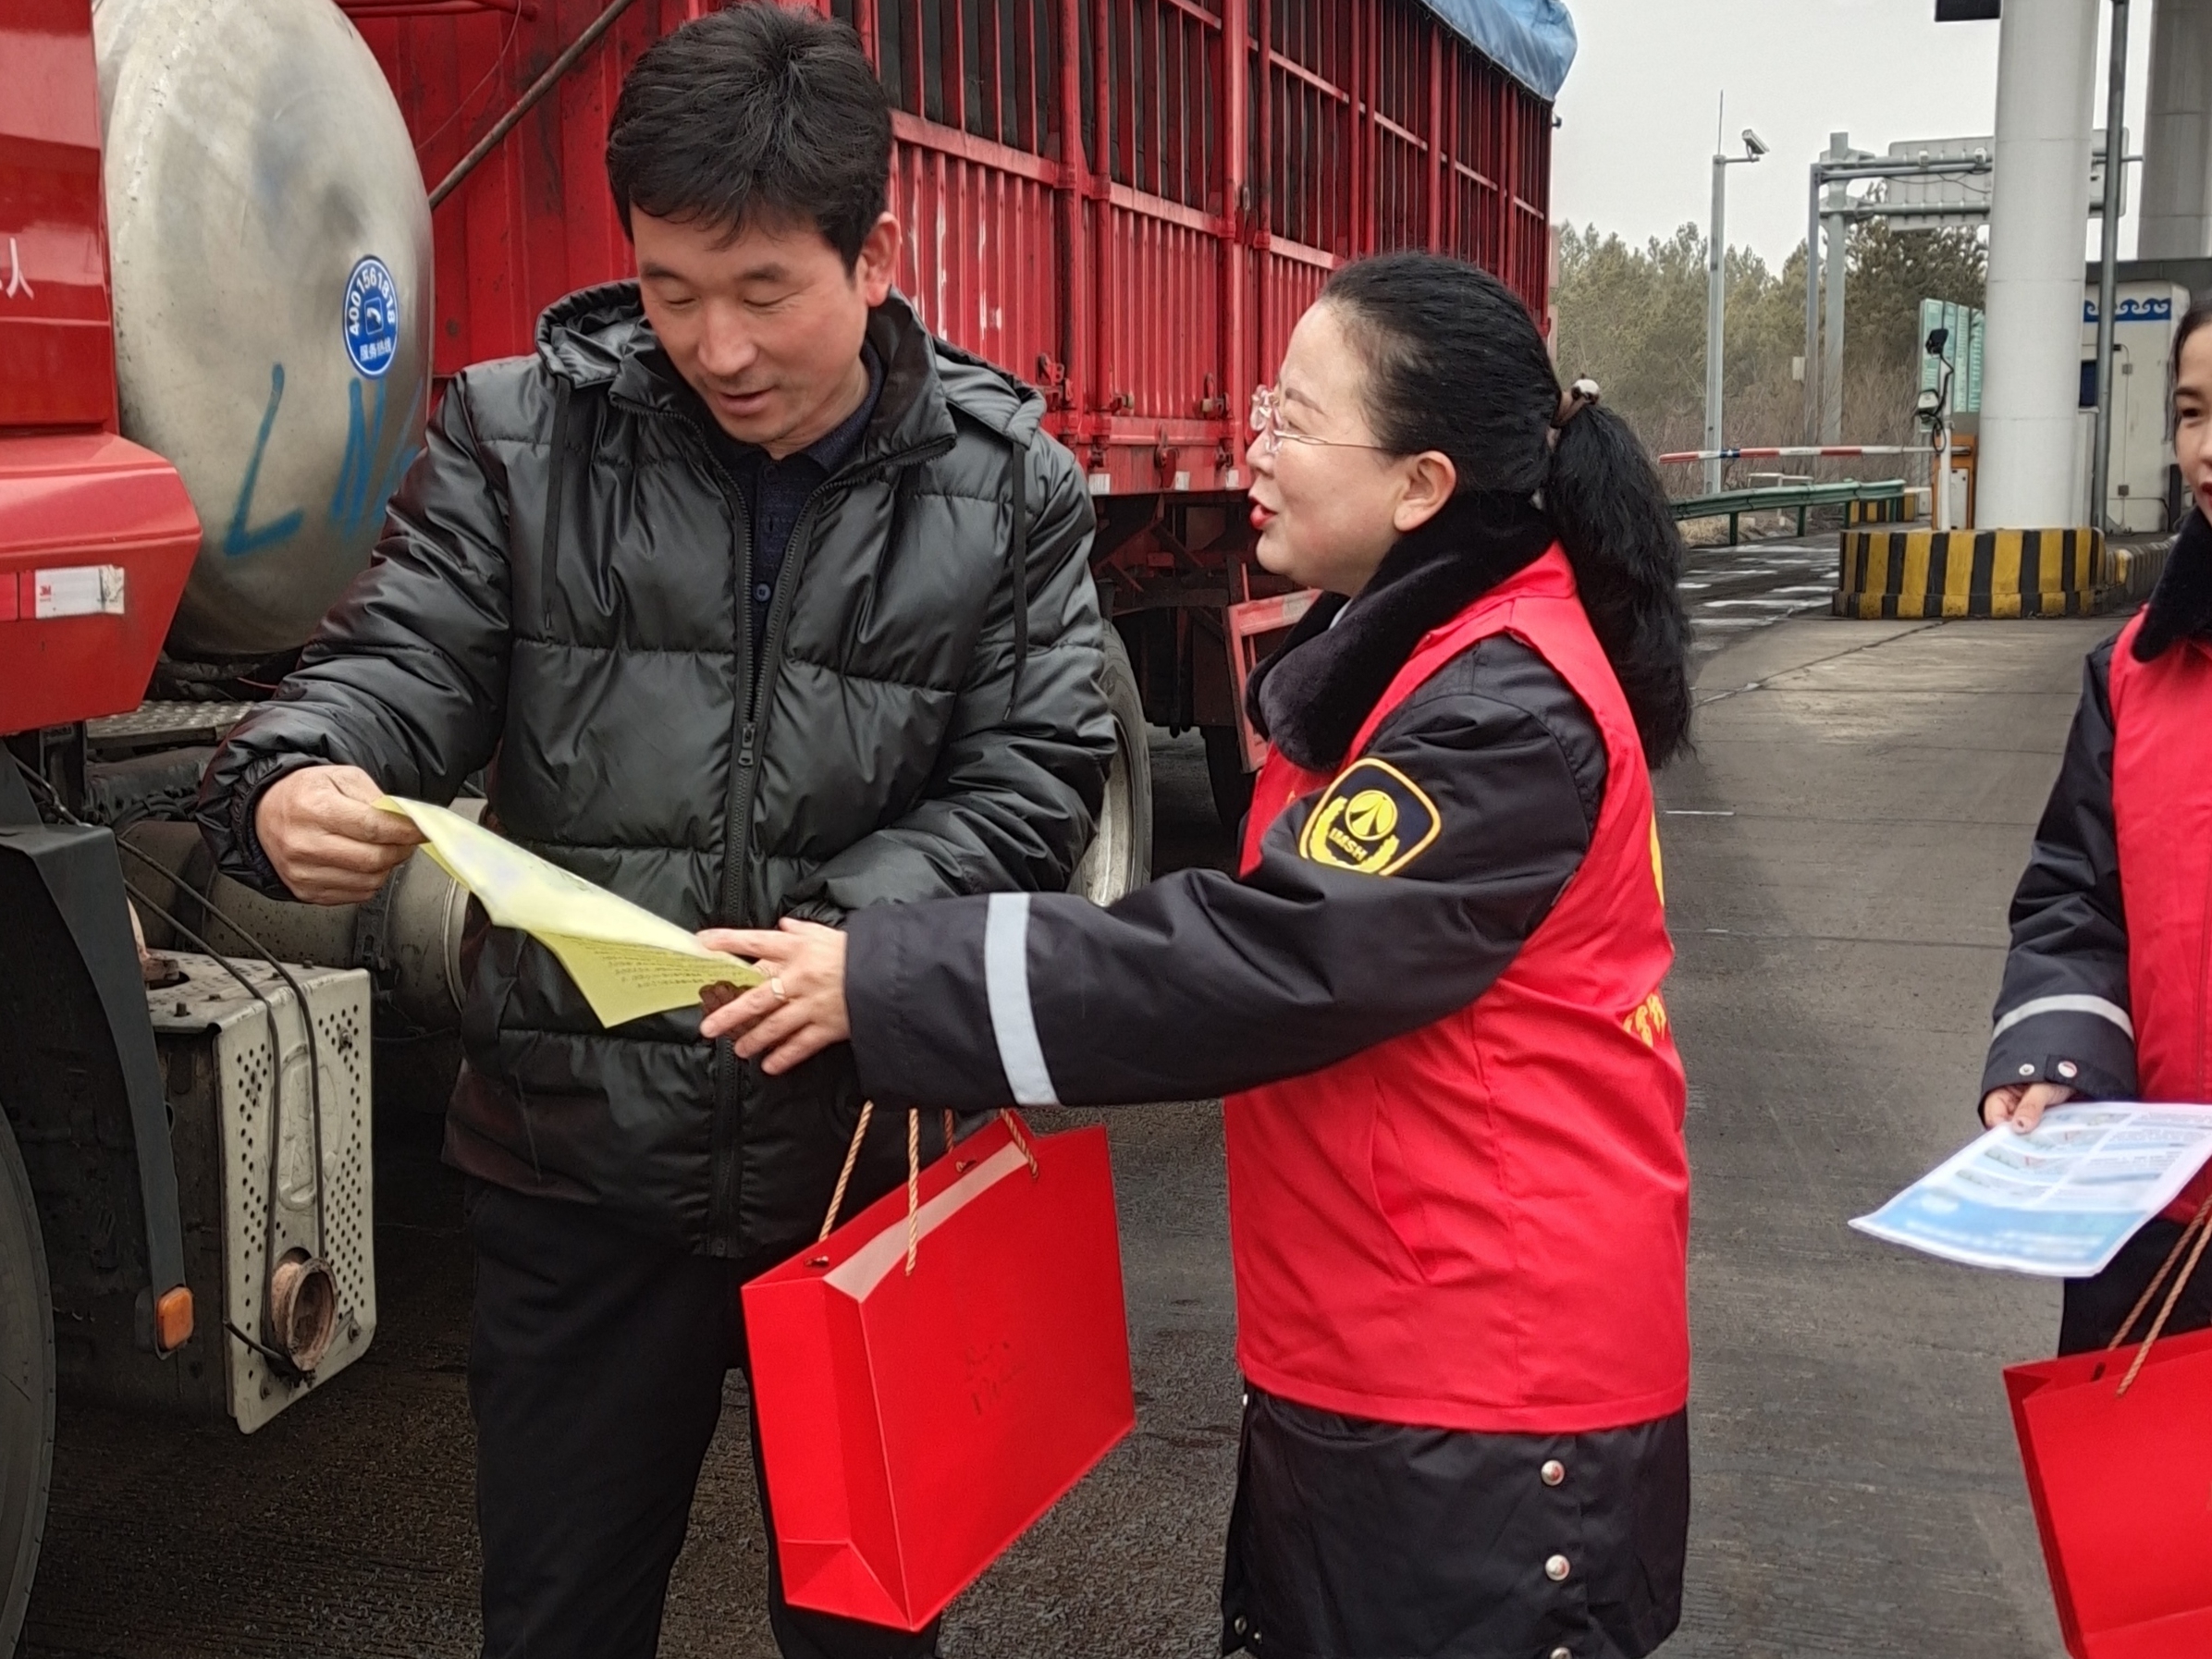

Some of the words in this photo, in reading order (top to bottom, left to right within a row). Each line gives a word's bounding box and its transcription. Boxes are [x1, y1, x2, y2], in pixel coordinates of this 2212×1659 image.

[0, 237, 34, 300] 人
[349, 266, 395, 336] 4001561818
[359, 337, 392, 362] 服务热线
